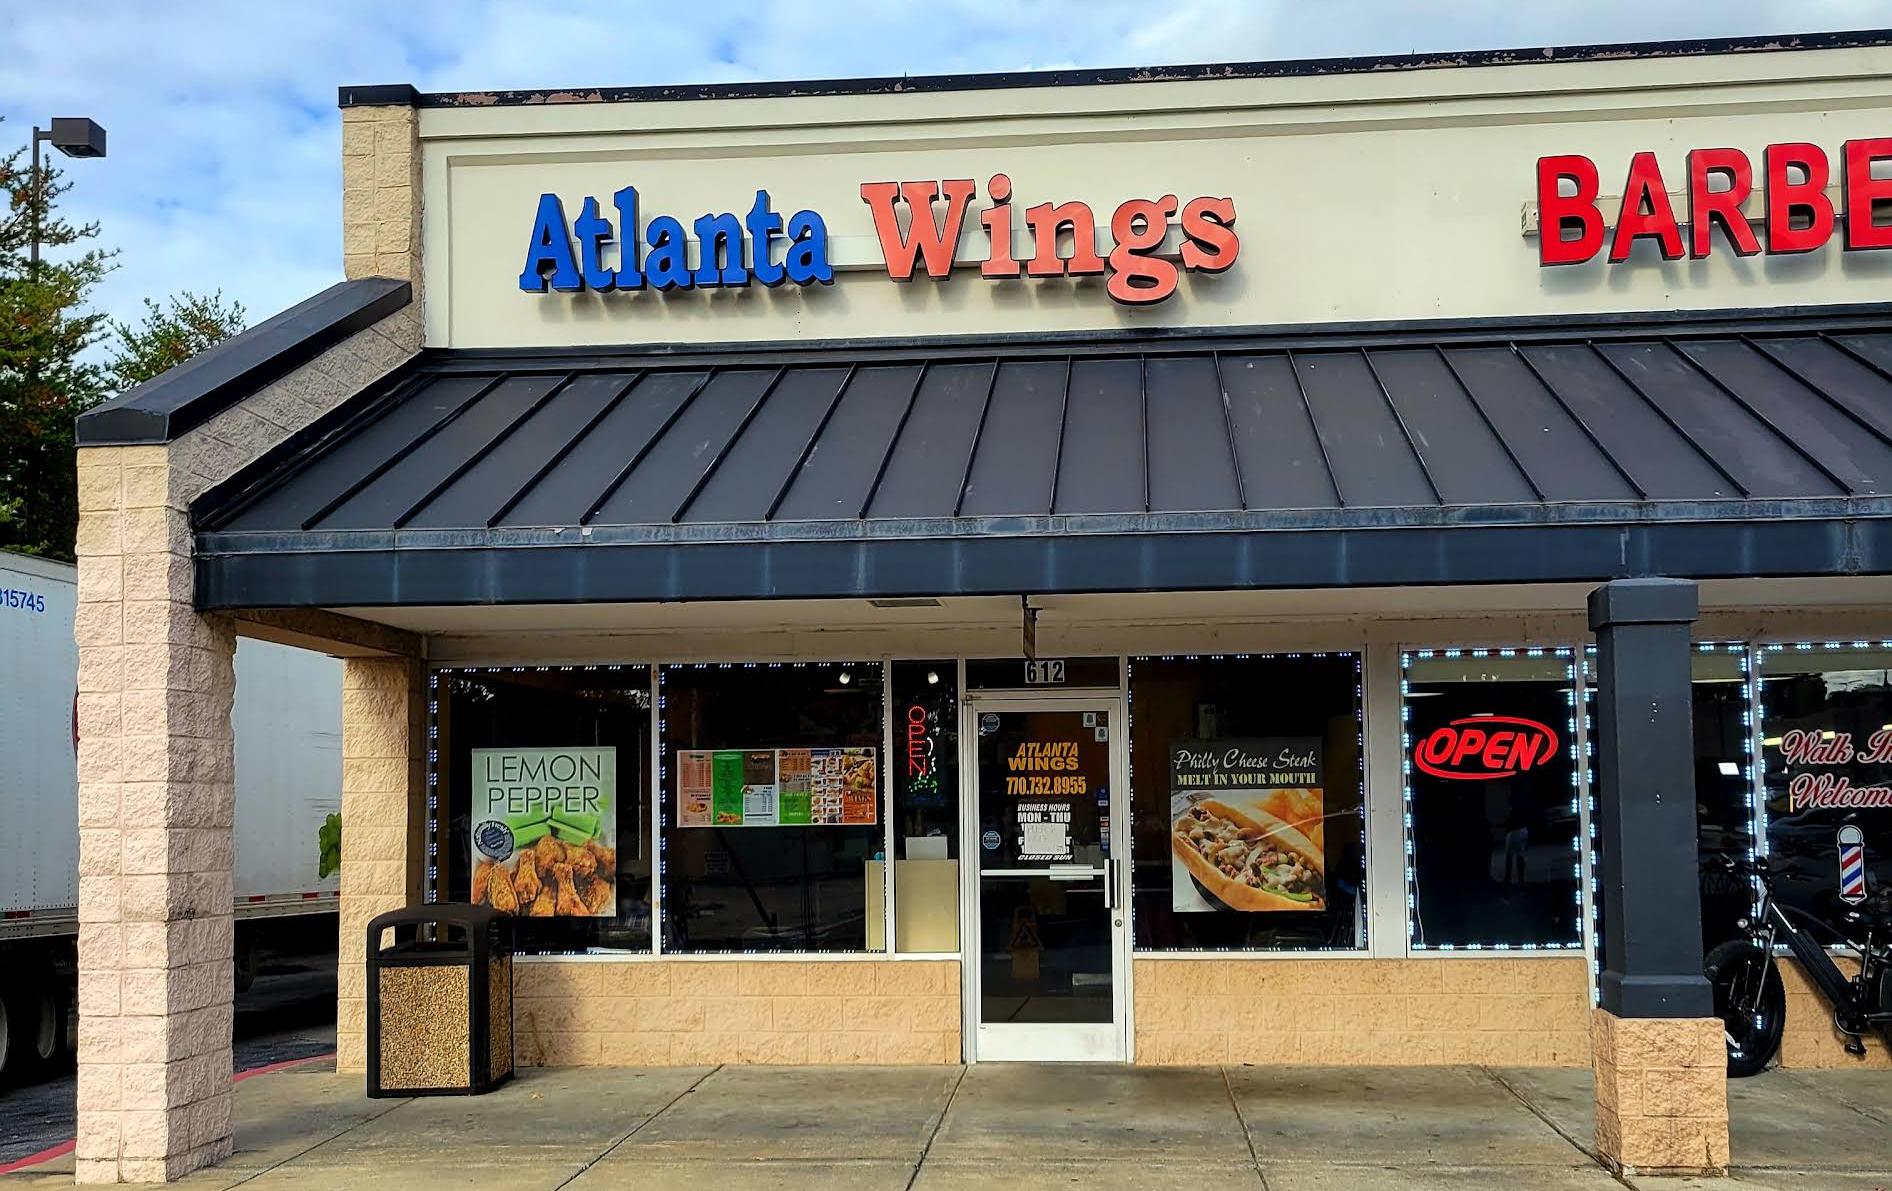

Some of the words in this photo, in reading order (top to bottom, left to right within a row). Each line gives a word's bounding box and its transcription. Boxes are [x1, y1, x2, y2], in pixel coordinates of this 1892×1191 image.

[1537, 137, 1892, 267] BARBE
[519, 186, 834, 293] Atlanta
[860, 173, 1240, 306] Wings
[1026, 661, 1064, 683] 612
[908, 705, 926, 776] OPEN
[1016, 741, 1079, 758] ATLANTA
[1424, 727, 1543, 771] OPEN
[1780, 729, 1854, 765] Walk
[486, 754, 601, 782] LEMON
[1007, 756, 1079, 771] WINGS
[1173, 749, 1220, 775] Philly
[1223, 748, 1268, 769] Cheese
[1272, 747, 1317, 769] Steak
[1006, 776, 1087, 795] 770.732.8955
[1177, 774, 1211, 786] MELT
[1214, 774, 1229, 785] IN
[1231, 773, 1267, 785] YOUR
[1269, 772, 1316, 784] MOUTH
[1789, 772, 1892, 809] Welcom
[488, 786, 600, 813] PEPPER
[1017, 803, 1048, 812] BUSINESS
[1048, 803, 1071, 812] HOURS
[1017, 812, 1041, 823] MON
[1049, 812, 1071, 823] THU
